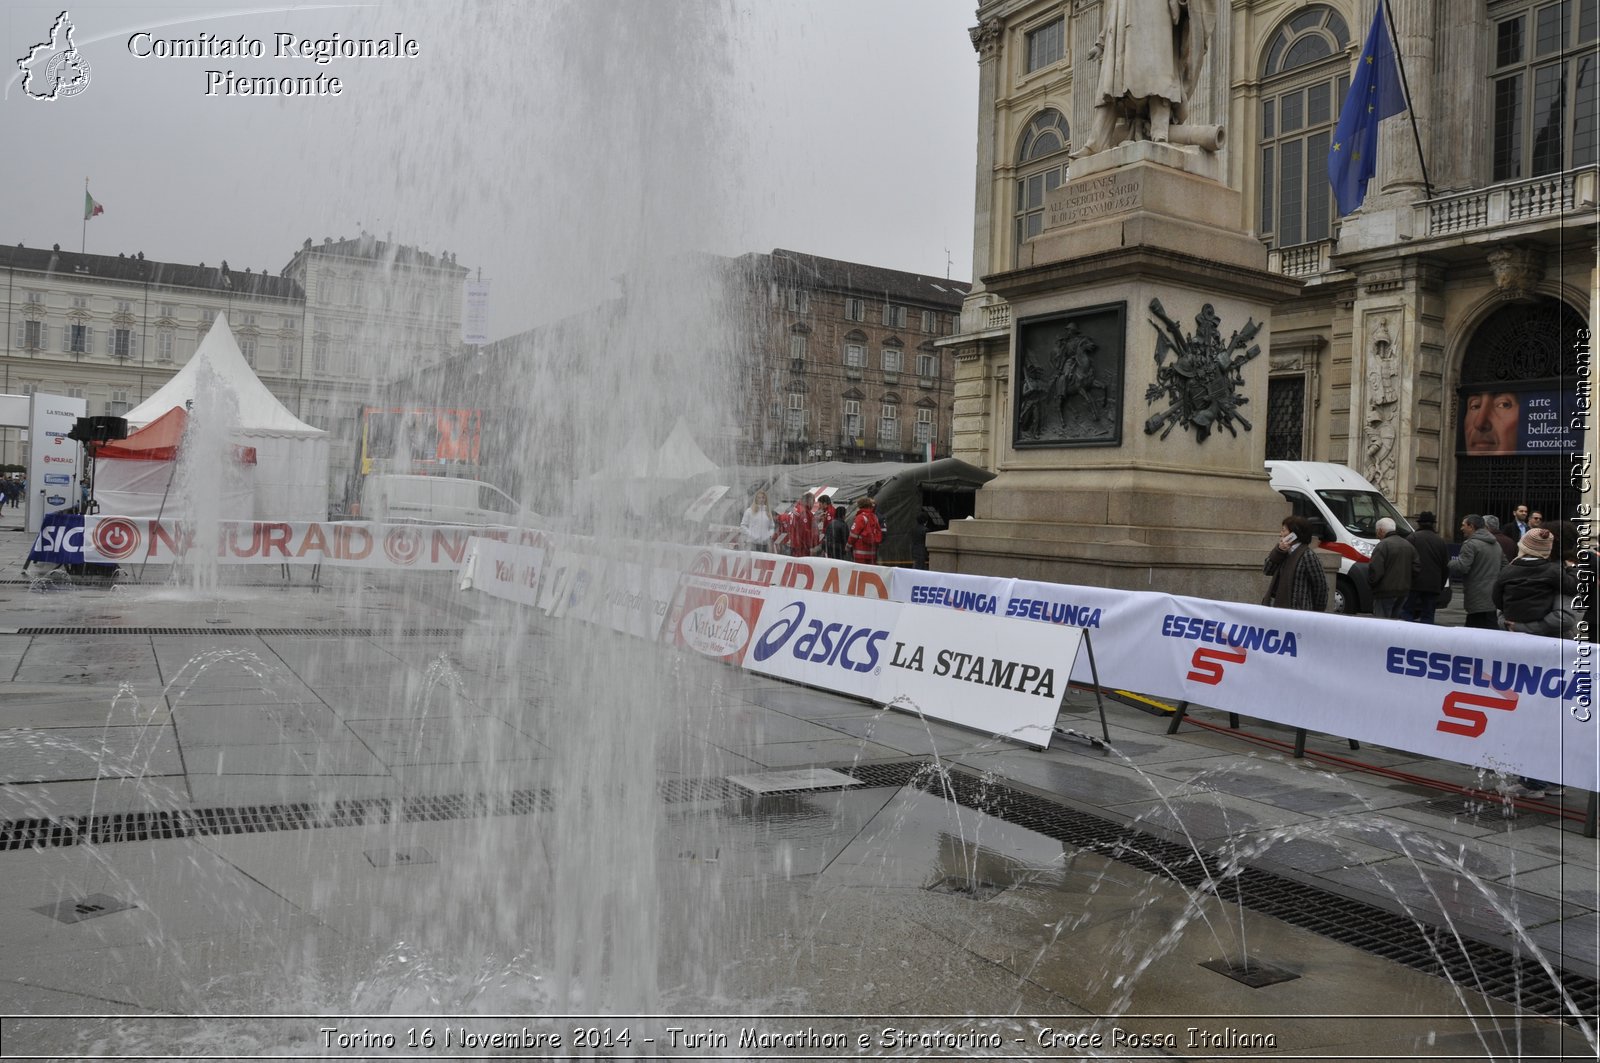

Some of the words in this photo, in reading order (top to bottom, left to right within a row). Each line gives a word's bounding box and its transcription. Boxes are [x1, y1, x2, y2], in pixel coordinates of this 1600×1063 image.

[1108, 182, 1139, 197] SARDO
[1079, 202, 1113, 217] GENNAIO
[1115, 195, 1138, 209] 1857
[1529, 398, 1551, 407] arte
[1528, 409, 1557, 420] storia
[1528, 423, 1569, 435] bellezza
[1526, 437, 1577, 448] emozione
[910, 585, 997, 615] ESSELUNGA
[1005, 598, 1102, 629] SSELUNGA
[1162, 614, 1297, 658] ESSELUNGA
[889, 642, 925, 672] LA
[933, 649, 1055, 699] STAMPA
[1386, 646, 1592, 701] ESSELUNGA
